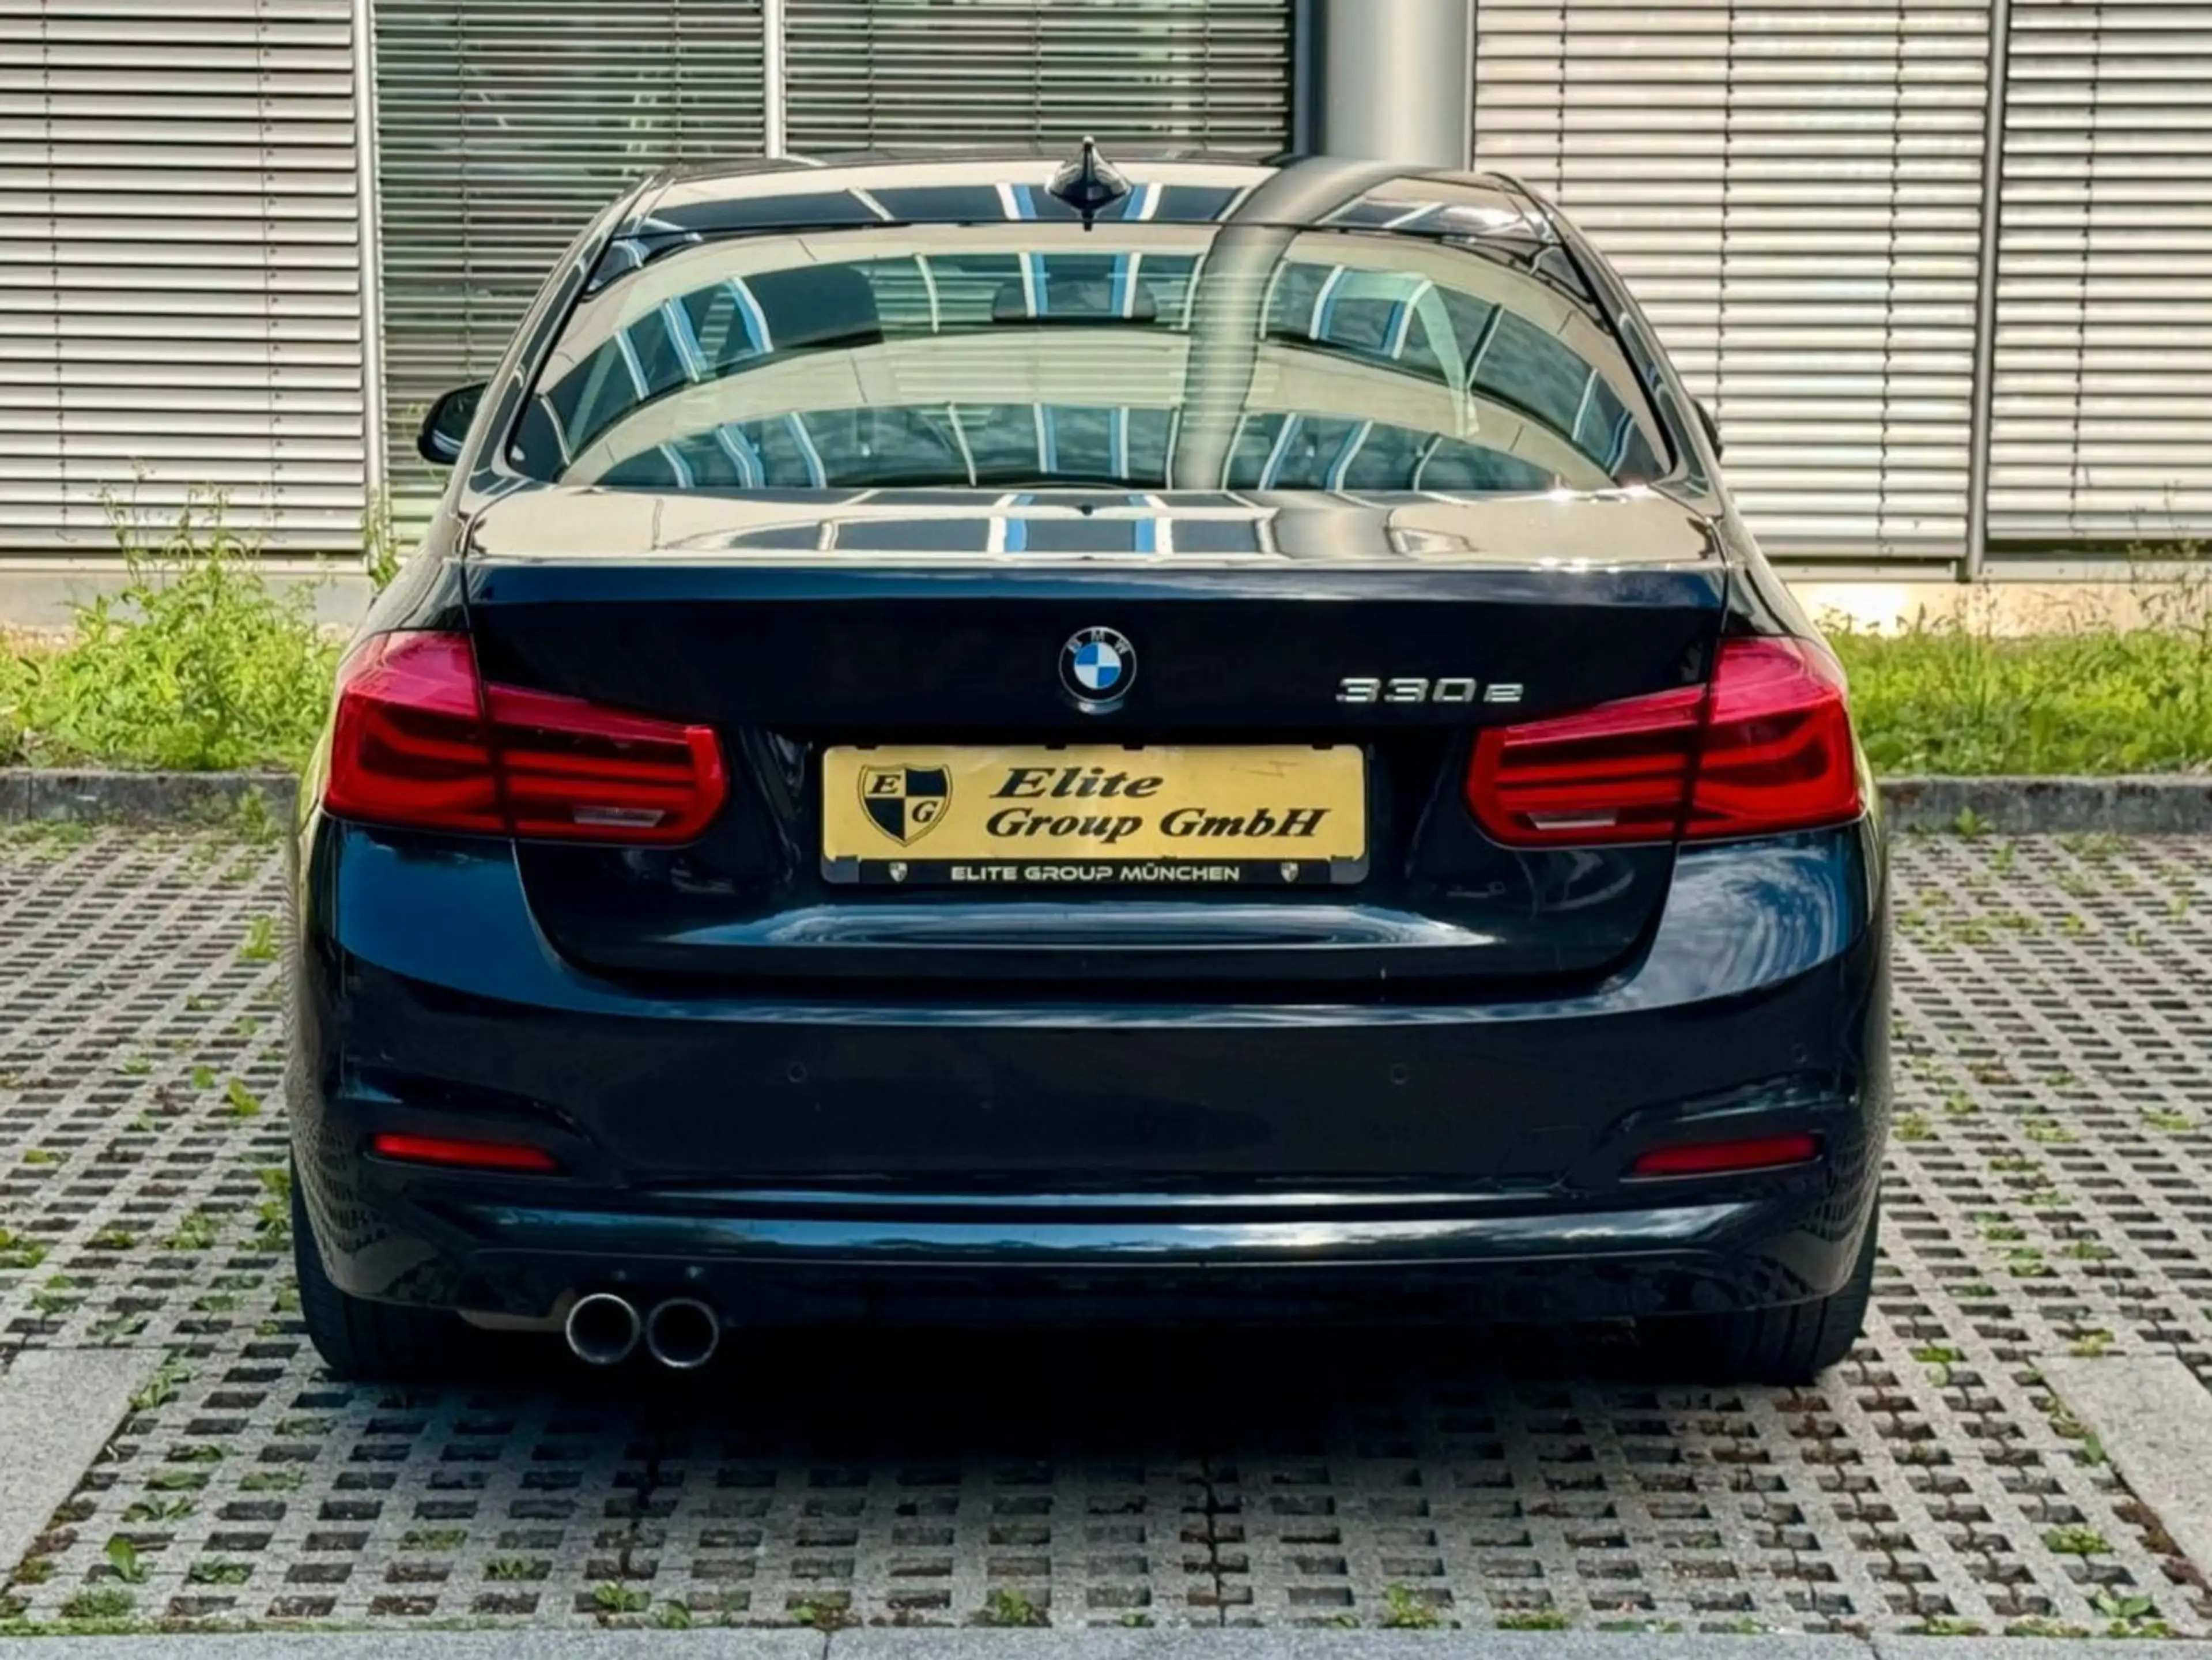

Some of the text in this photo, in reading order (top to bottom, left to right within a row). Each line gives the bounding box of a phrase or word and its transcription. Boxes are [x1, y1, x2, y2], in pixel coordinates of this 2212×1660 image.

[1067, 626, 1130, 655] BMW
[868, 774, 901, 794] E
[988, 766, 1164, 799] Elite
[911, 801, 938, 823] G
[986, 807, 1332, 844] Group GmbH
[951, 862, 1240, 881] ELITE GROUP MÜNCHEN
